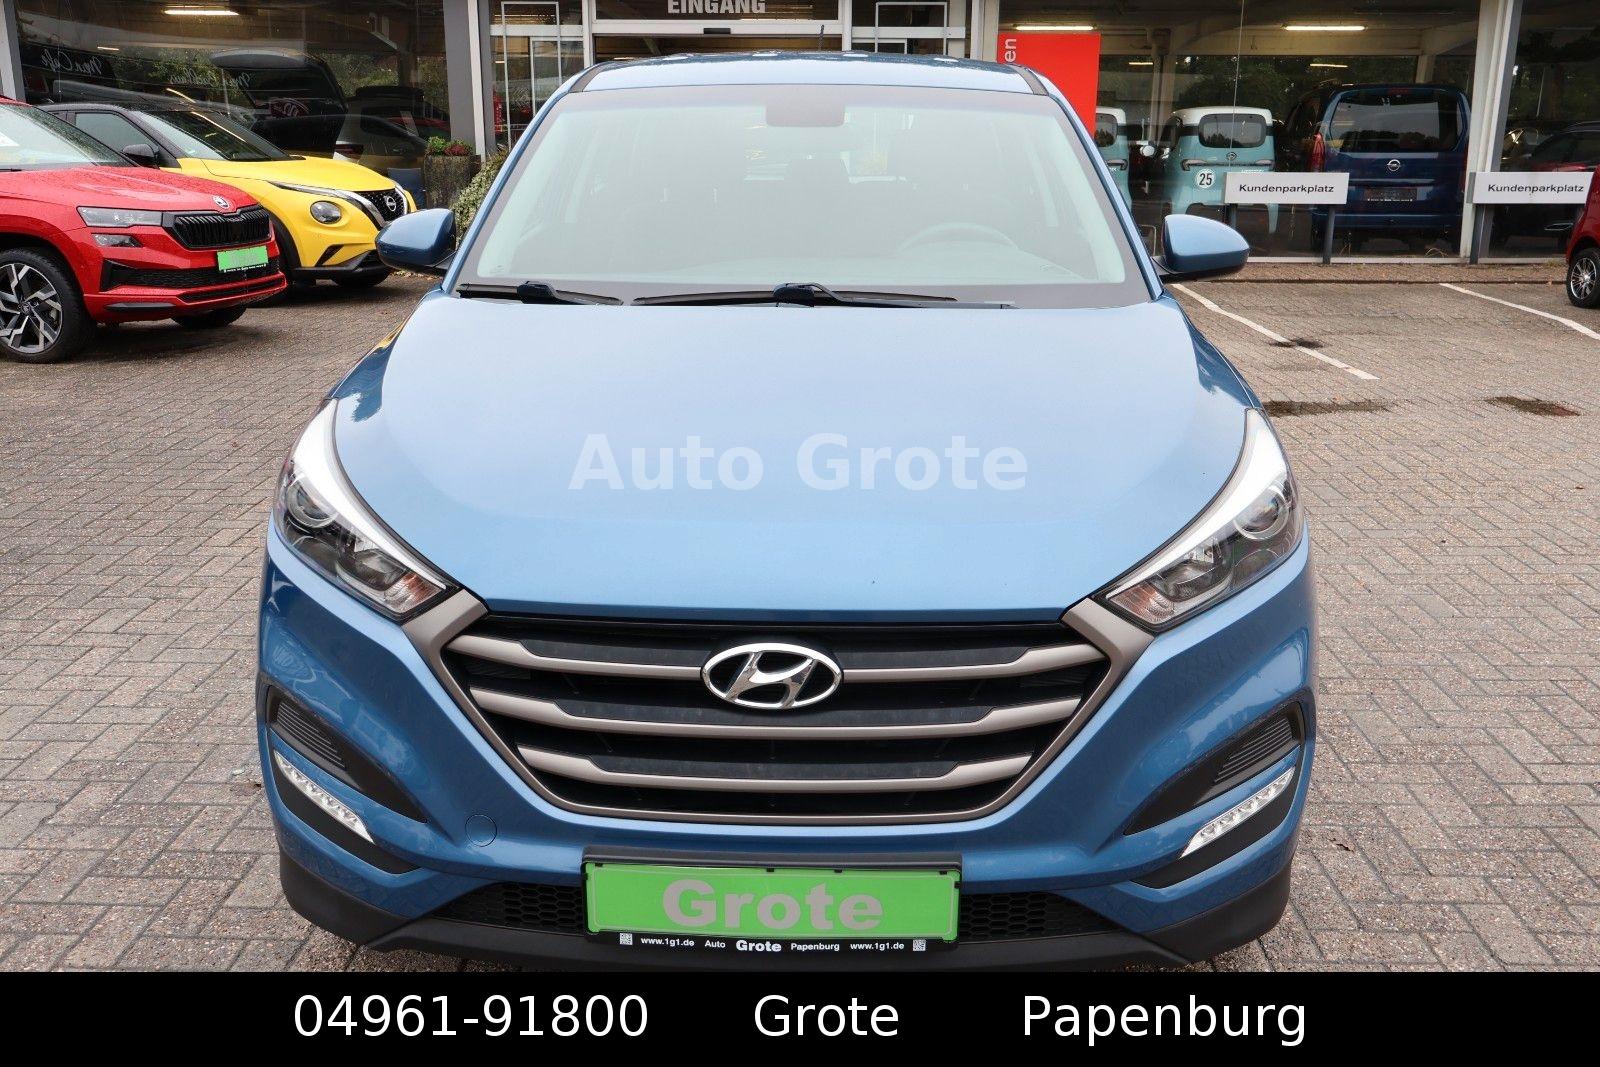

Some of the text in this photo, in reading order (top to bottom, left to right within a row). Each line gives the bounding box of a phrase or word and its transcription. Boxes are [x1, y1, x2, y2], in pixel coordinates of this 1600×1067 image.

[667, 0, 766, 13] EINGANG
[1199, 172, 1212, 186] 25
[1239, 183, 1335, 195] Kundenparkplatz
[1487, 183, 1585, 195] Kundenparkplatz
[663, 879, 883, 930] Grote
[641, 936, 905, 952] www.1g1.de Auto Grote Papenburg www.1g1.de
